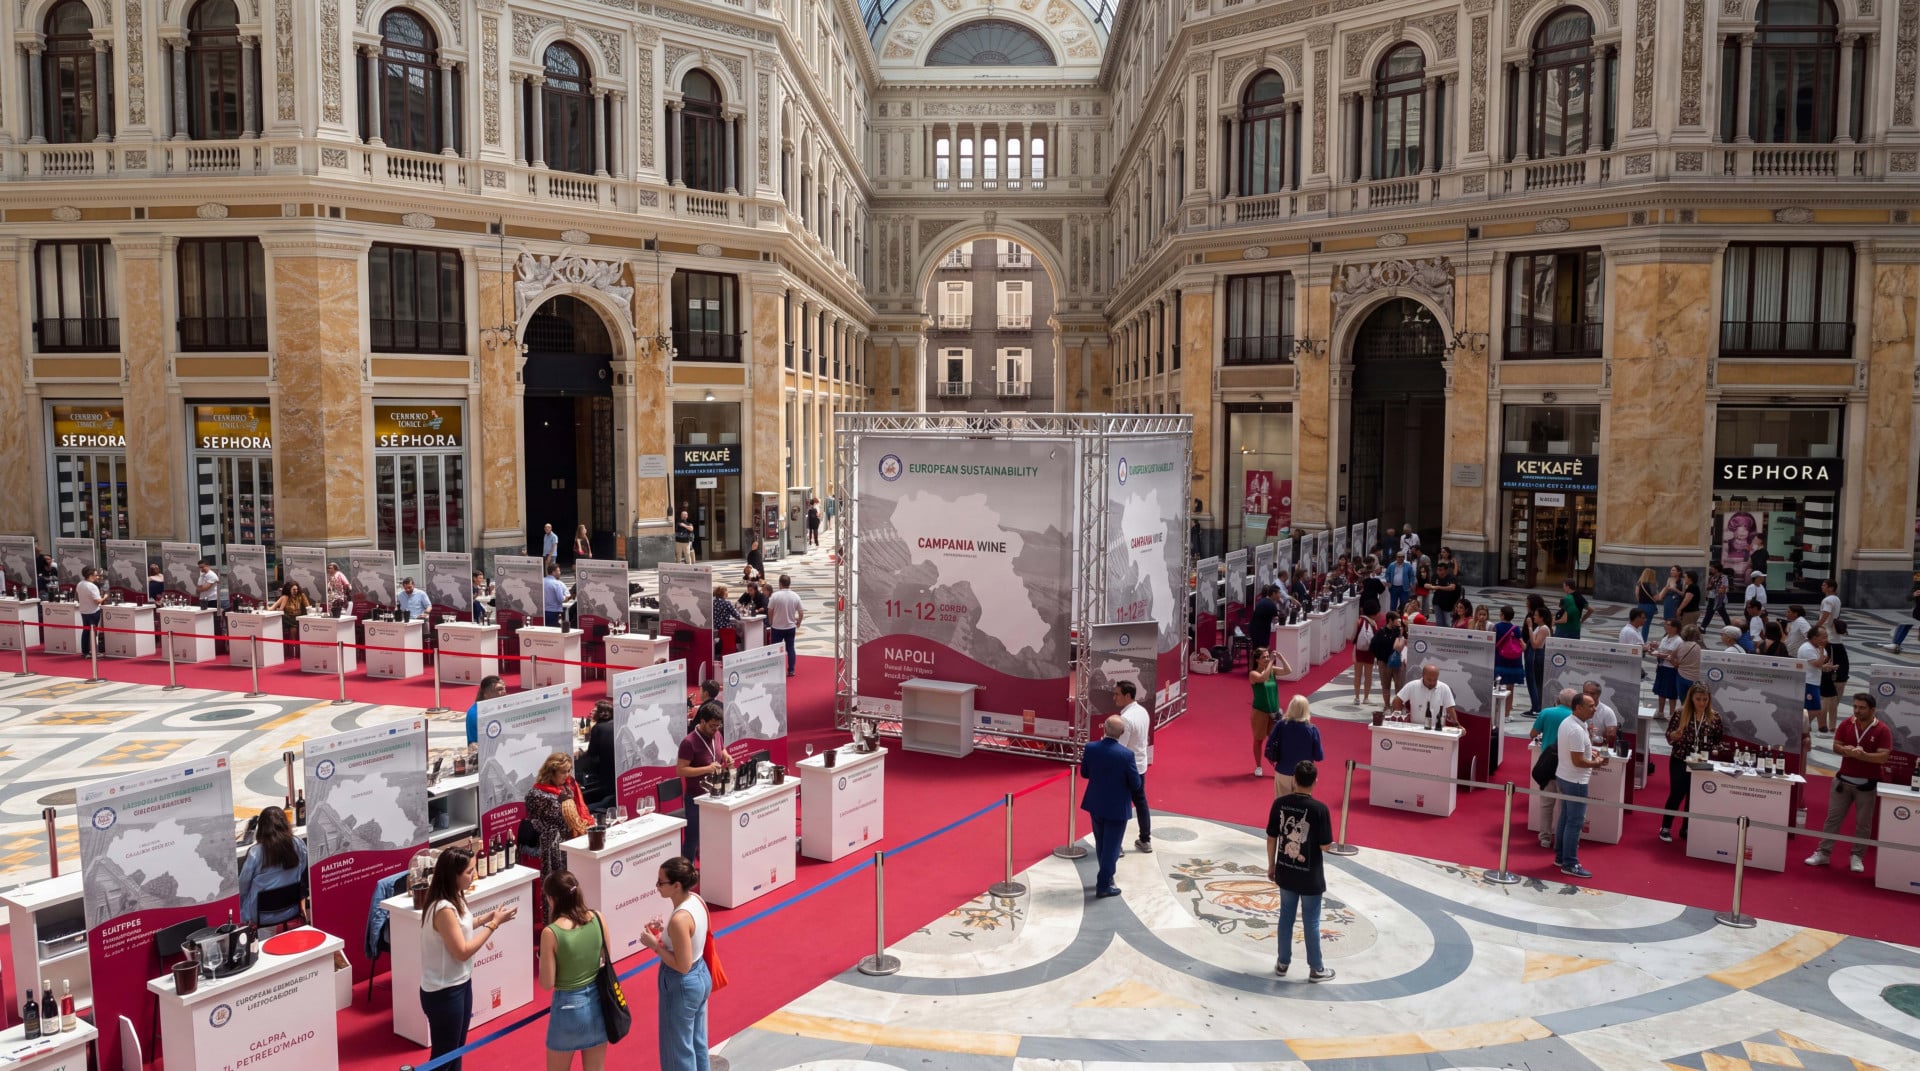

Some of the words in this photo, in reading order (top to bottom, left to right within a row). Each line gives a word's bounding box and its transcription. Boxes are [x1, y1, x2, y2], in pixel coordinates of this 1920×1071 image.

[203, 436, 272, 448] SEPHORA
[909, 463, 958, 474] EUROPEAN
[960, 465, 1038, 477] SUSTAINABILITY
[1723, 464, 1829, 480] SEPHORA
[918, 537, 975, 551] CAMPANIA
[977, 541, 1006, 553] WINE
[884, 647, 935, 665] NAPOLI
[249, 1031, 287, 1051] CALPRA
